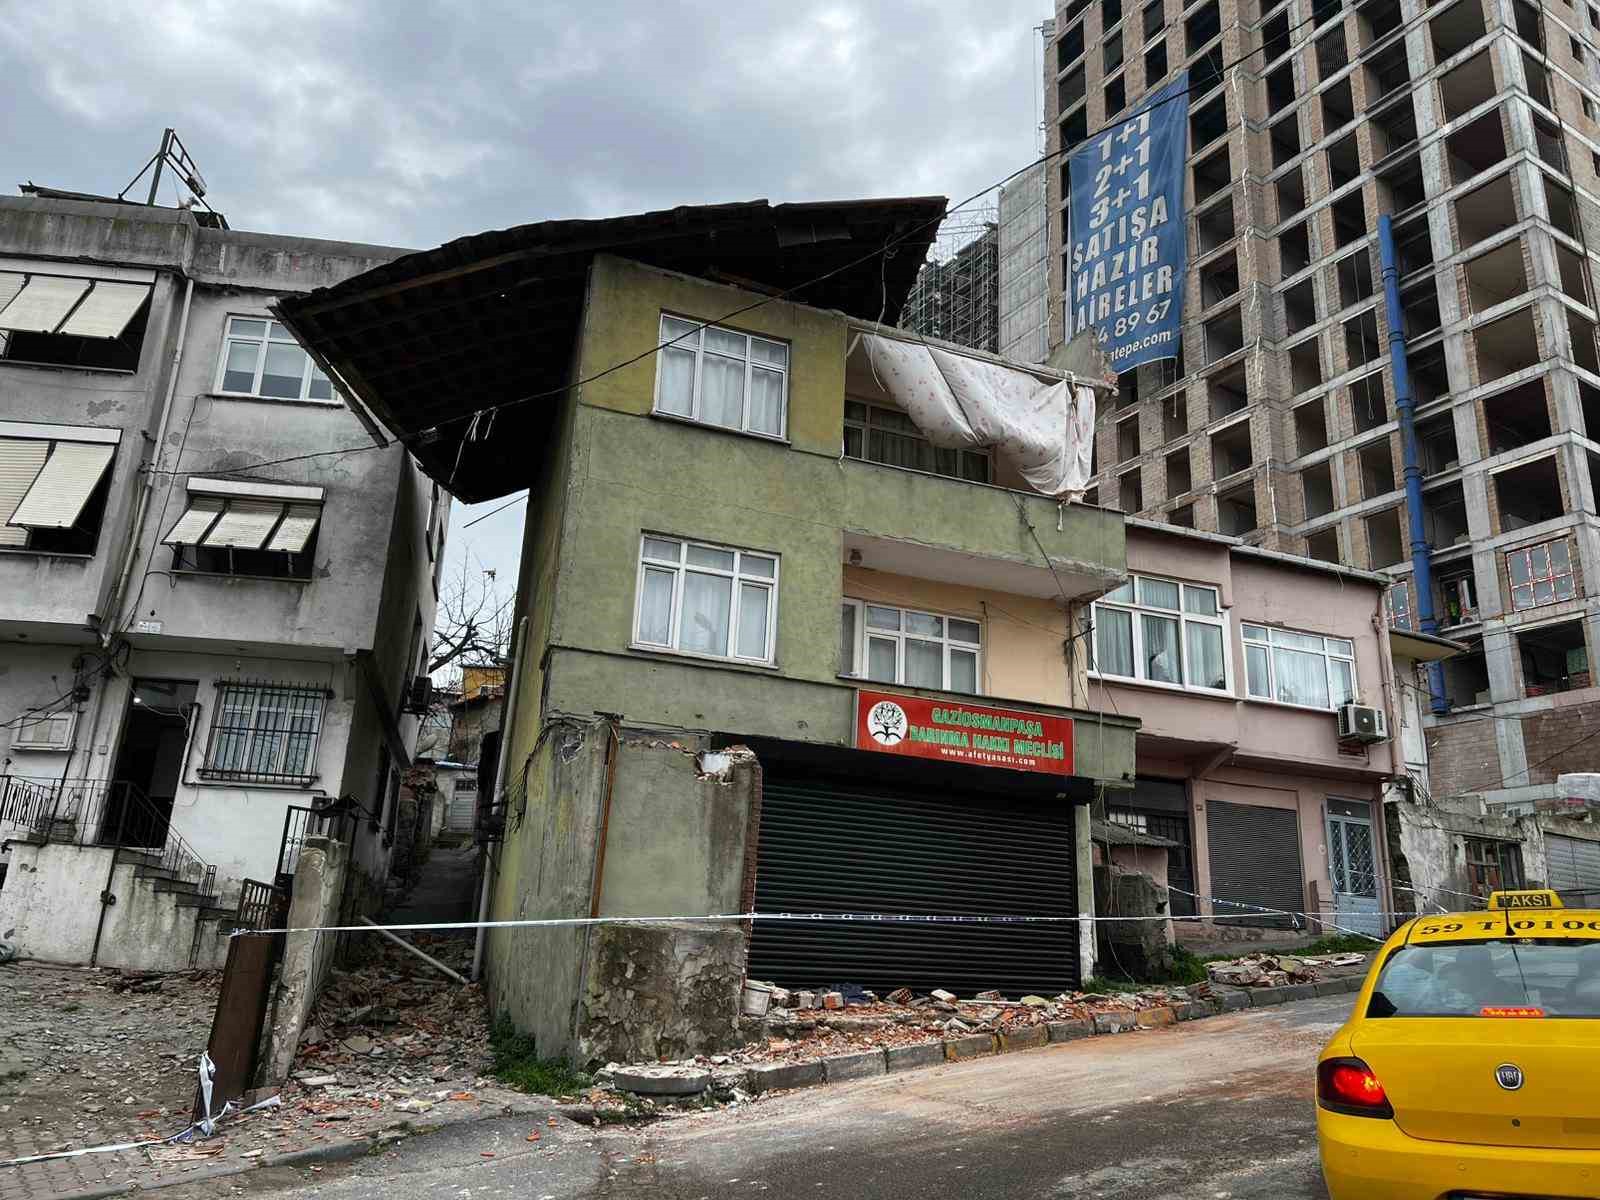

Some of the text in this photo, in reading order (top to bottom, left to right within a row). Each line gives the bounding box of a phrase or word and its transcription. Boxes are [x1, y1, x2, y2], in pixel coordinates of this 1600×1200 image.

[1098, 105, 1151, 161] 1+1
[1094, 135, 1150, 199] 2+1
[1089, 169, 1149, 229] 3+1
[1072, 195, 1168, 272] SATIŞA
[1076, 235, 1158, 303] HAZIR
[1114, 312, 1141, 337] 89
[1145, 299, 1171, 324] 67
[931, 707, 1044, 739] GAZİOSMANPAŞA
[1013, 738, 1064, 760] MECLİSİ
[1420, 923, 1463, 935] 59
[1476, 921, 1501, 931] T
